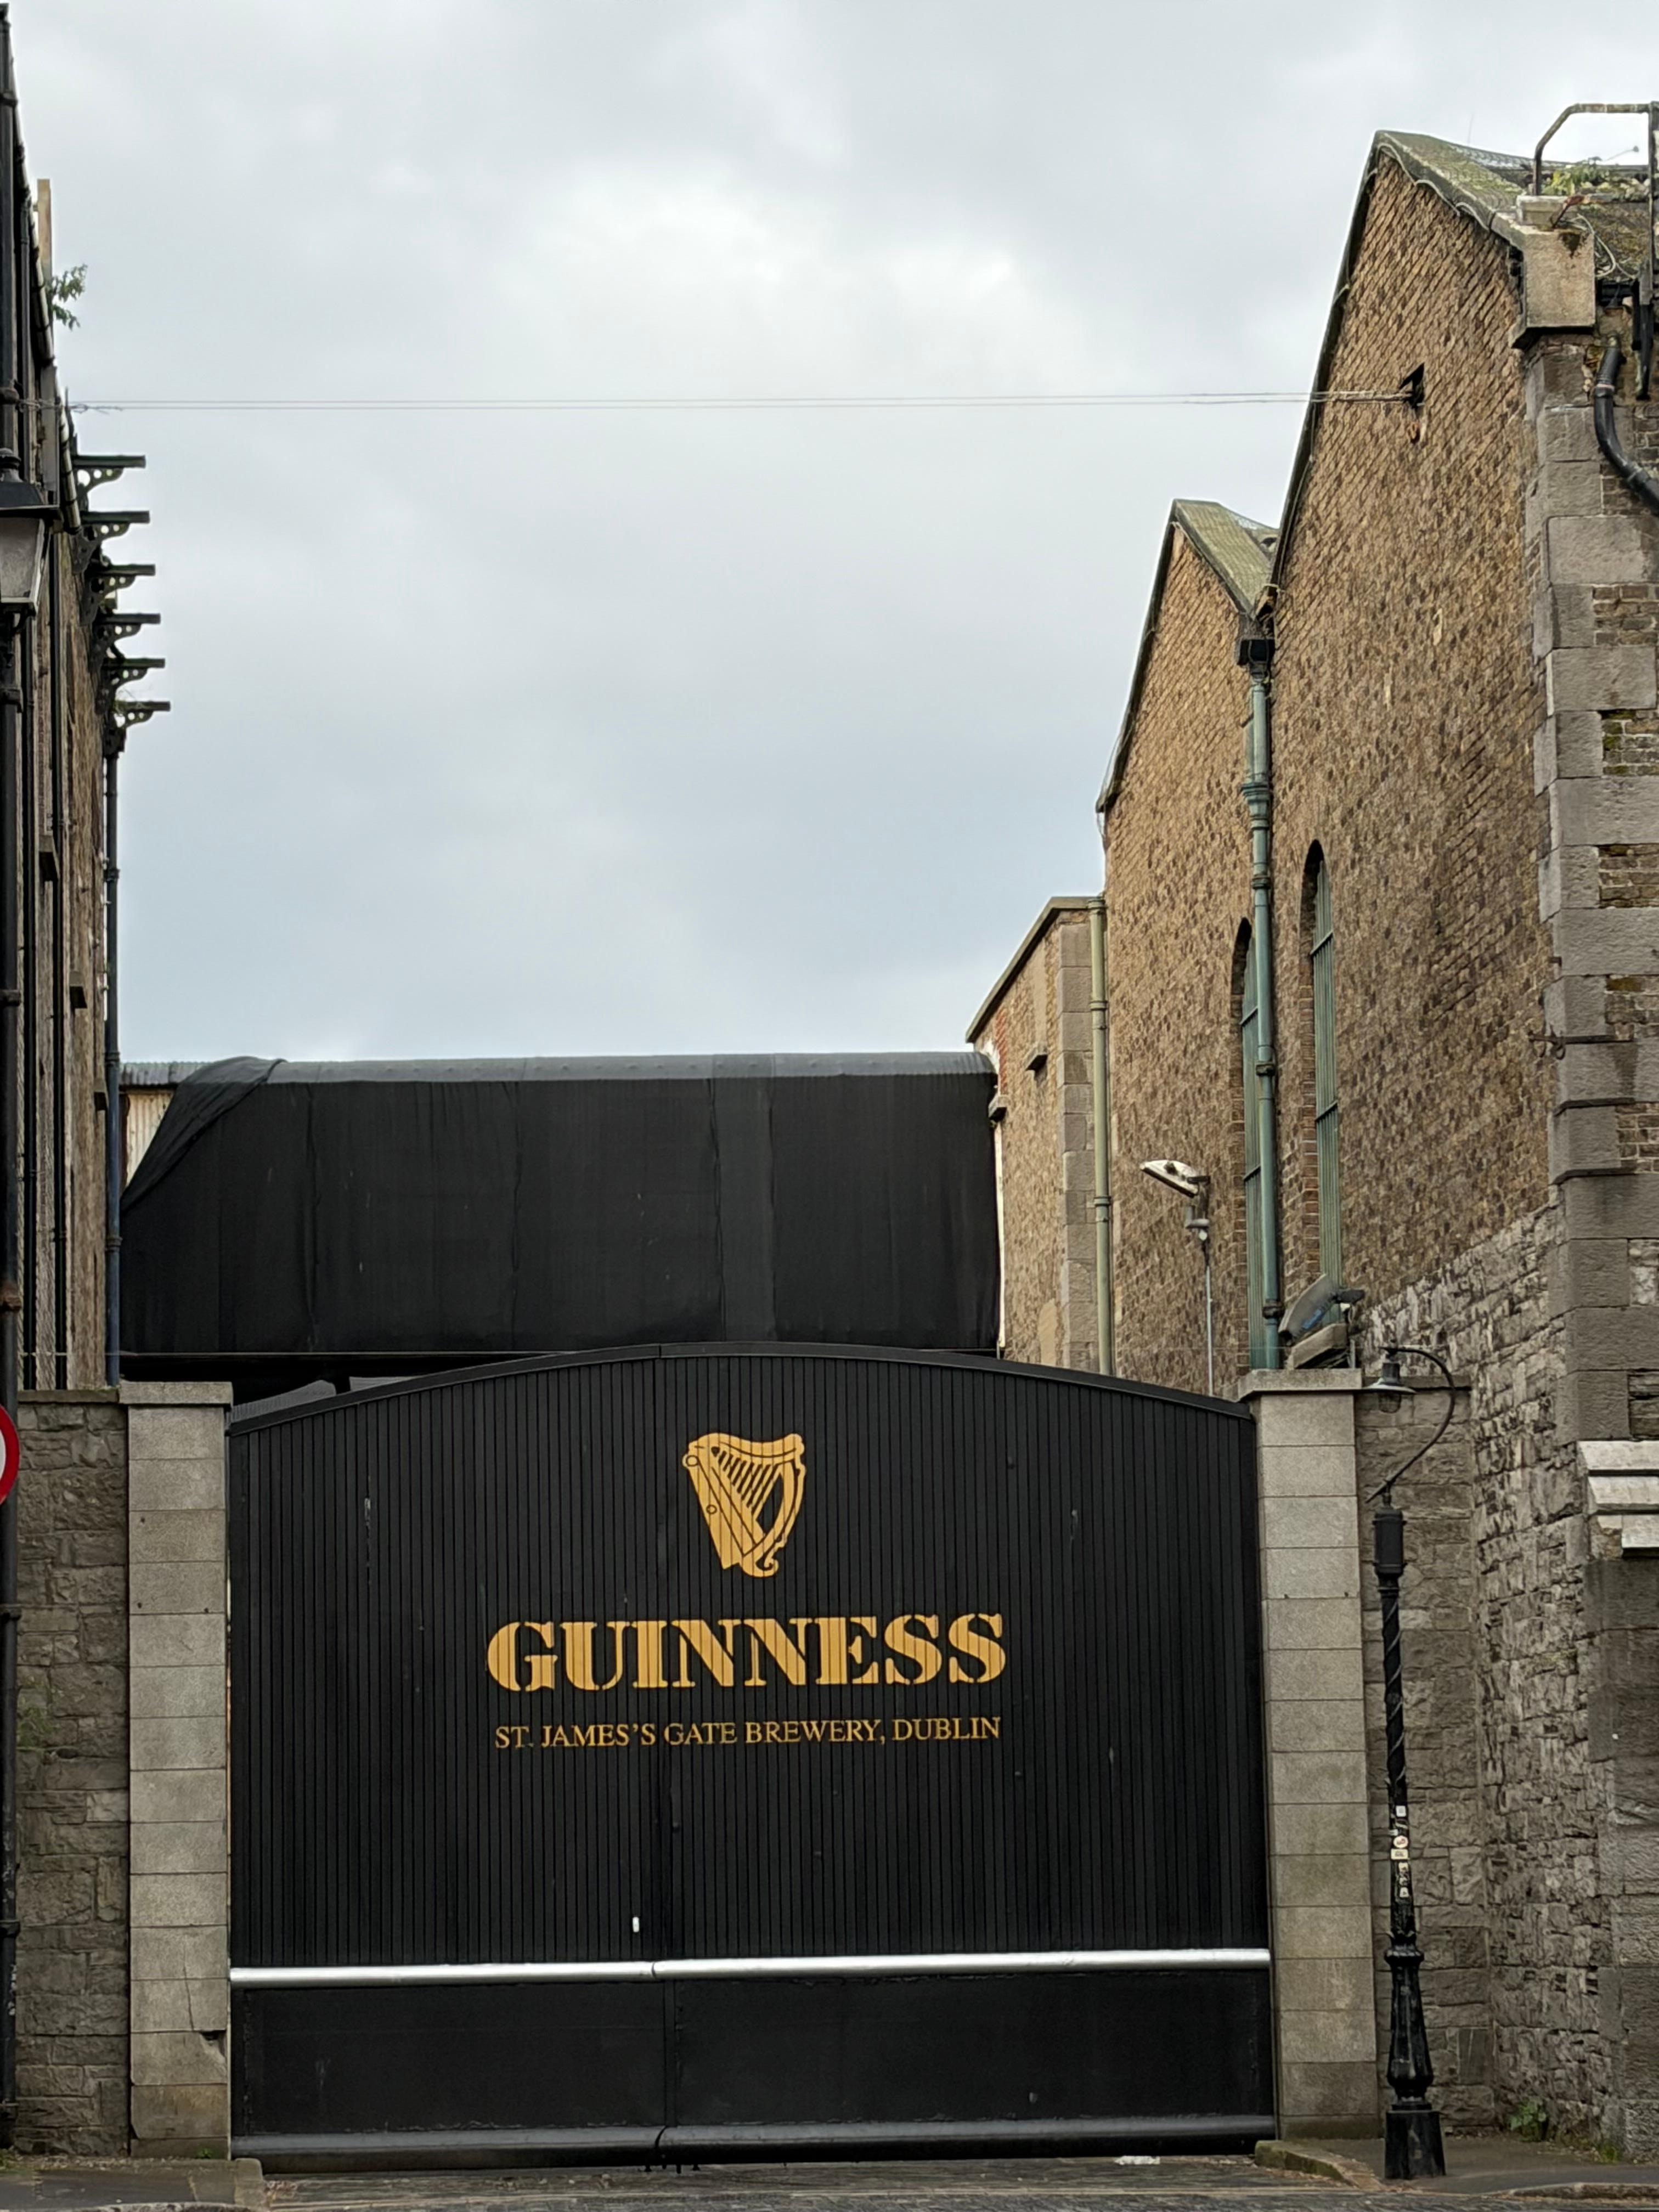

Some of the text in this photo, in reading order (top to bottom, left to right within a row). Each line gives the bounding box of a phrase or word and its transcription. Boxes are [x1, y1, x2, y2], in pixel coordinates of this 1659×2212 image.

[486, 1613, 1007, 1692] GUINNESS
[495, 1717, 1001, 1748] ST. JAMES'S GATE BREWERY, DUBLIN
